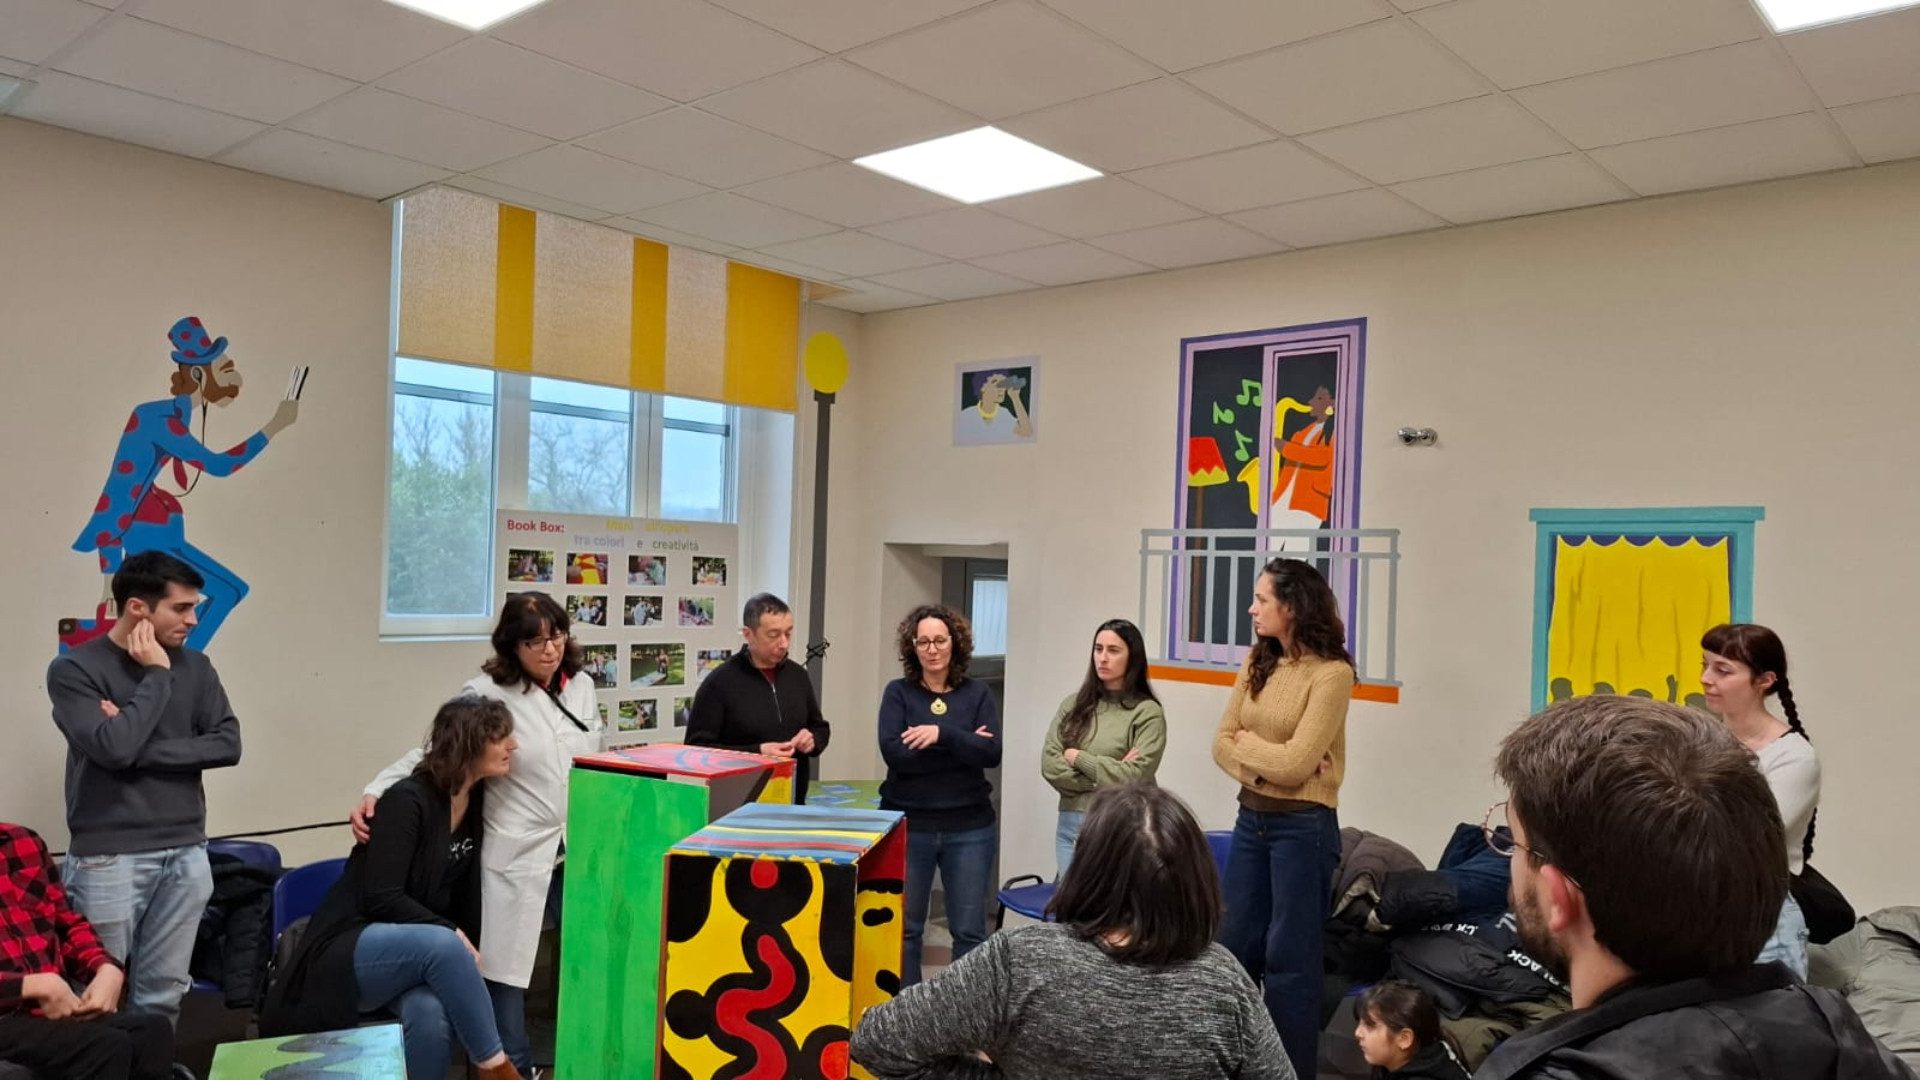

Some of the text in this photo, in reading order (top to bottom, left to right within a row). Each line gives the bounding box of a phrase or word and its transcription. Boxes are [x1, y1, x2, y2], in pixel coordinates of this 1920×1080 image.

[507, 519, 565, 533] Book Box:
[574, 534, 699, 551] tra colori e creatività
